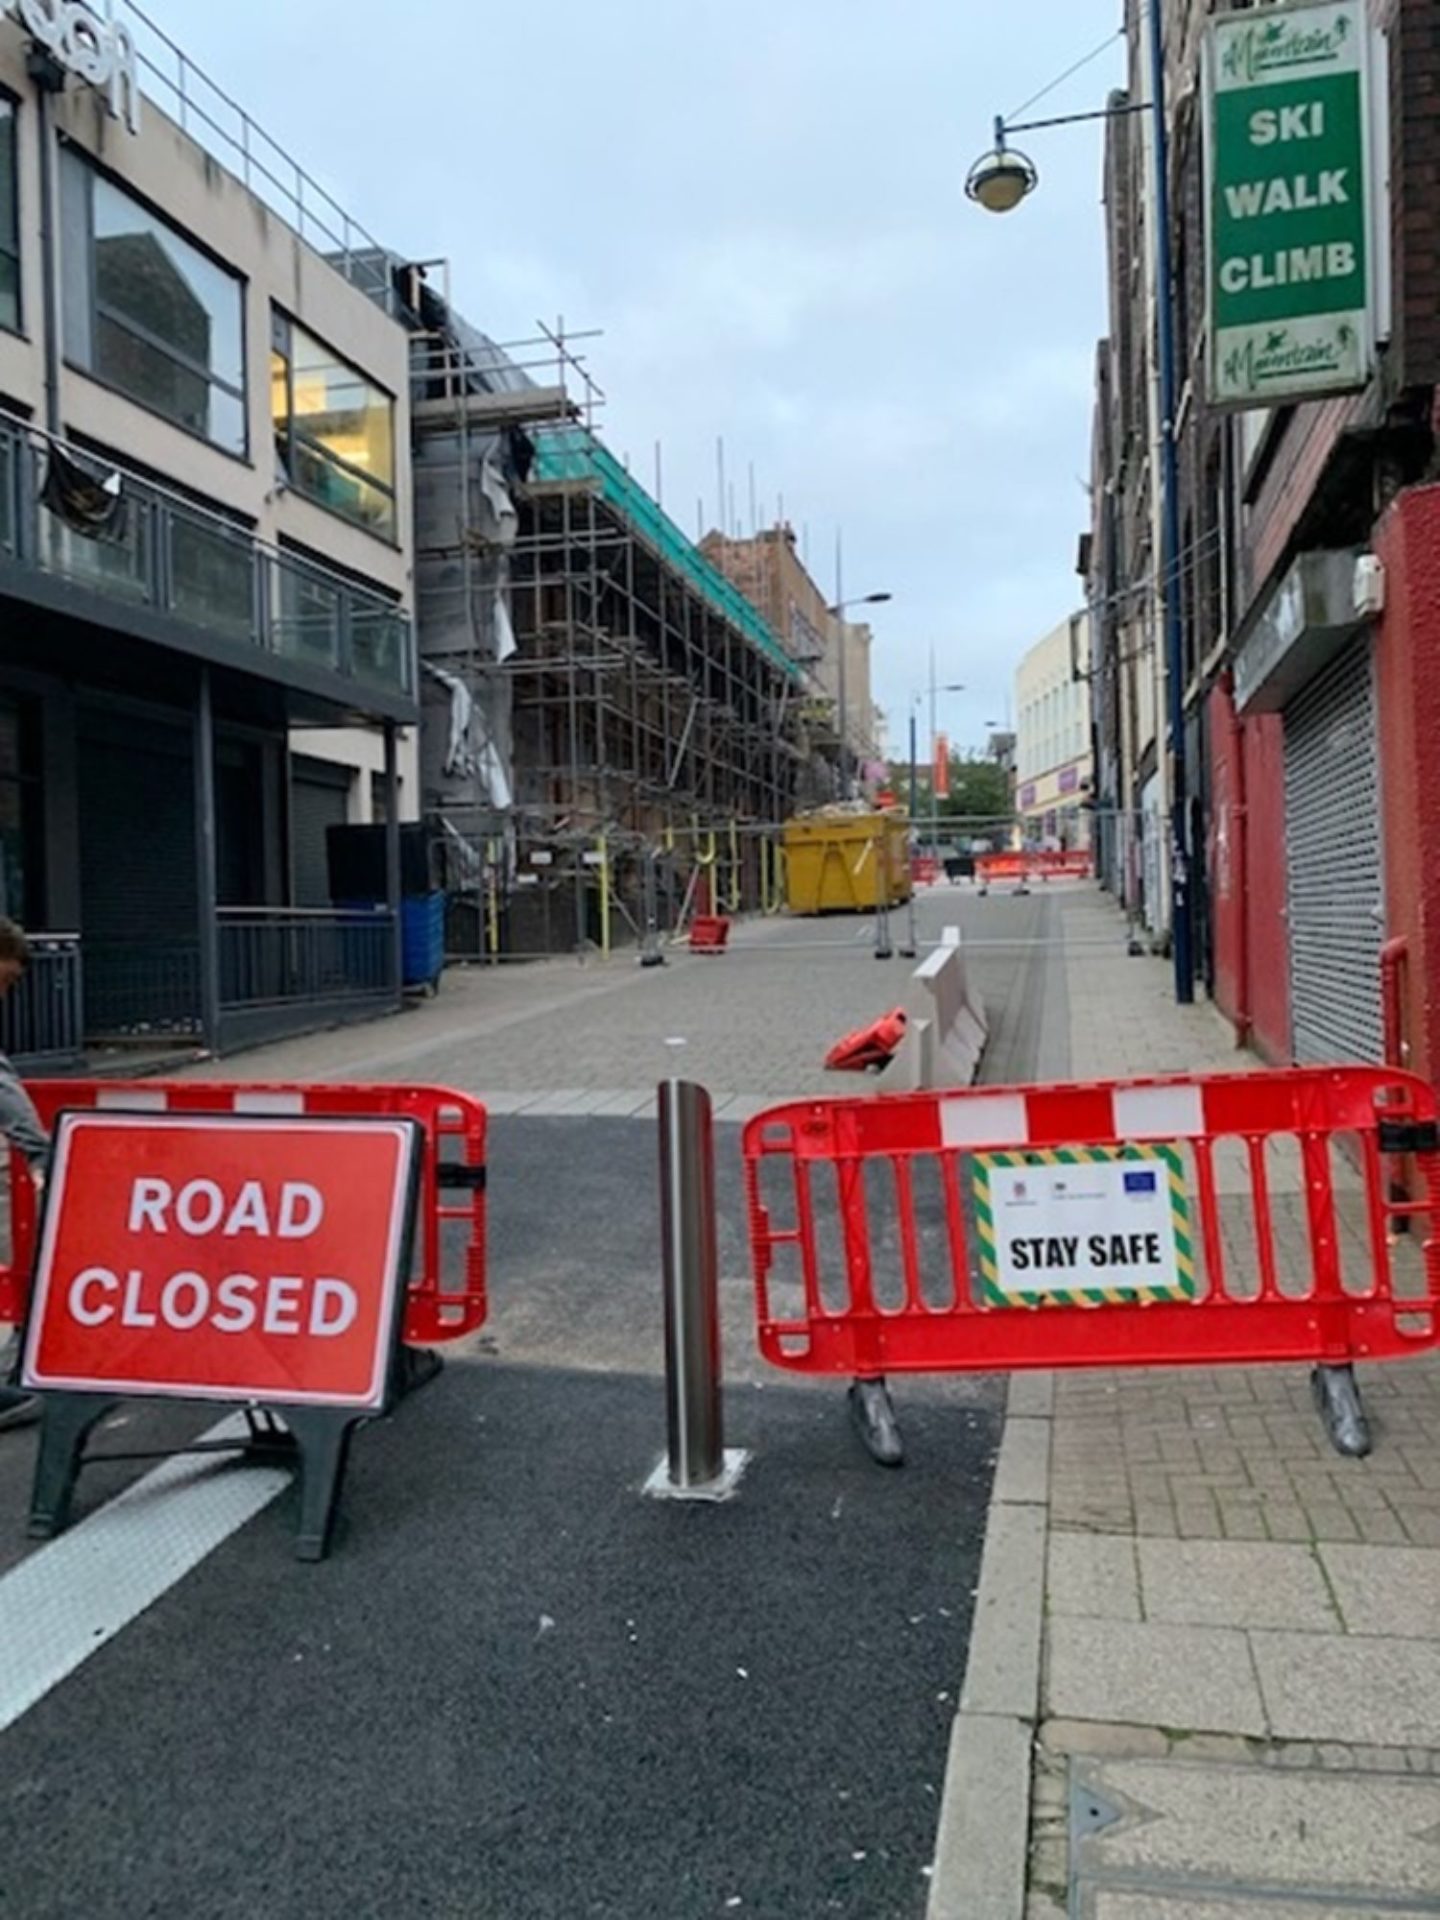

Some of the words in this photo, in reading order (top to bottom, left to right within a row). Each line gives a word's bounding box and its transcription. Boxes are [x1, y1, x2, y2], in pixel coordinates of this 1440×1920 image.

[1248, 101, 1325, 145] SKI
[1225, 168, 1348, 219] WALK
[1219, 241, 1356, 293] CLIMB
[128, 1177, 324, 1238] ROAD
[1010, 1237, 1079, 1270] STAY
[1088, 1233, 1161, 1267] SAFE
[68, 1267, 359, 1337] CLOSED
